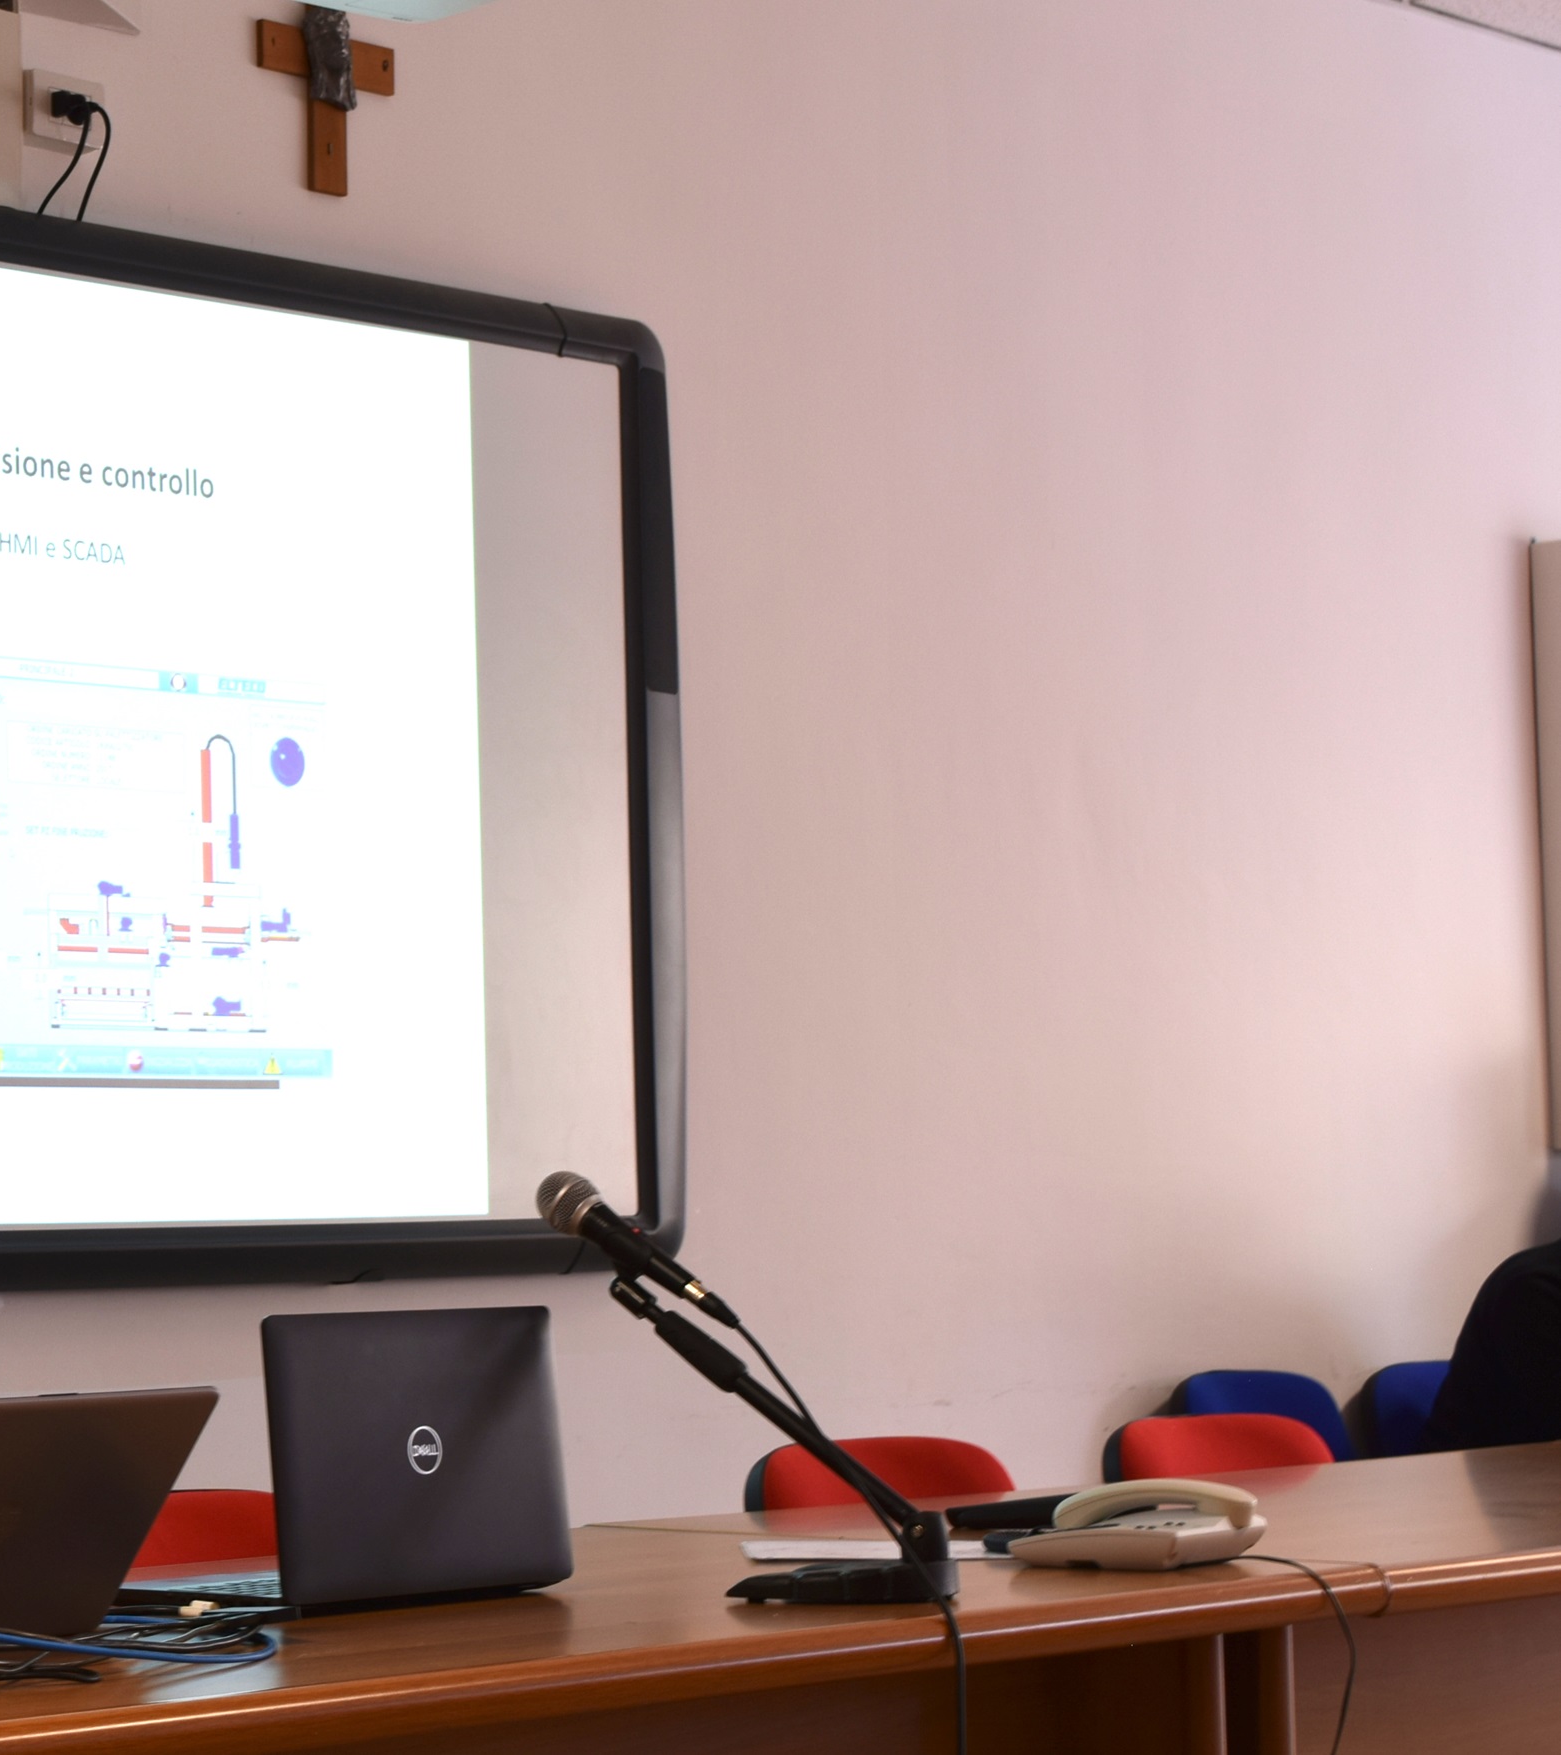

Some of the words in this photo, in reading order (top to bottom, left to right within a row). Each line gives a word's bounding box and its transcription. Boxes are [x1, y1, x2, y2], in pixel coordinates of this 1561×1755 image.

[79, 462, 93, 484] e
[102, 467, 215, 499] controllo
[45, 541, 57, 558] e
[62, 538, 126, 565] SCADA
